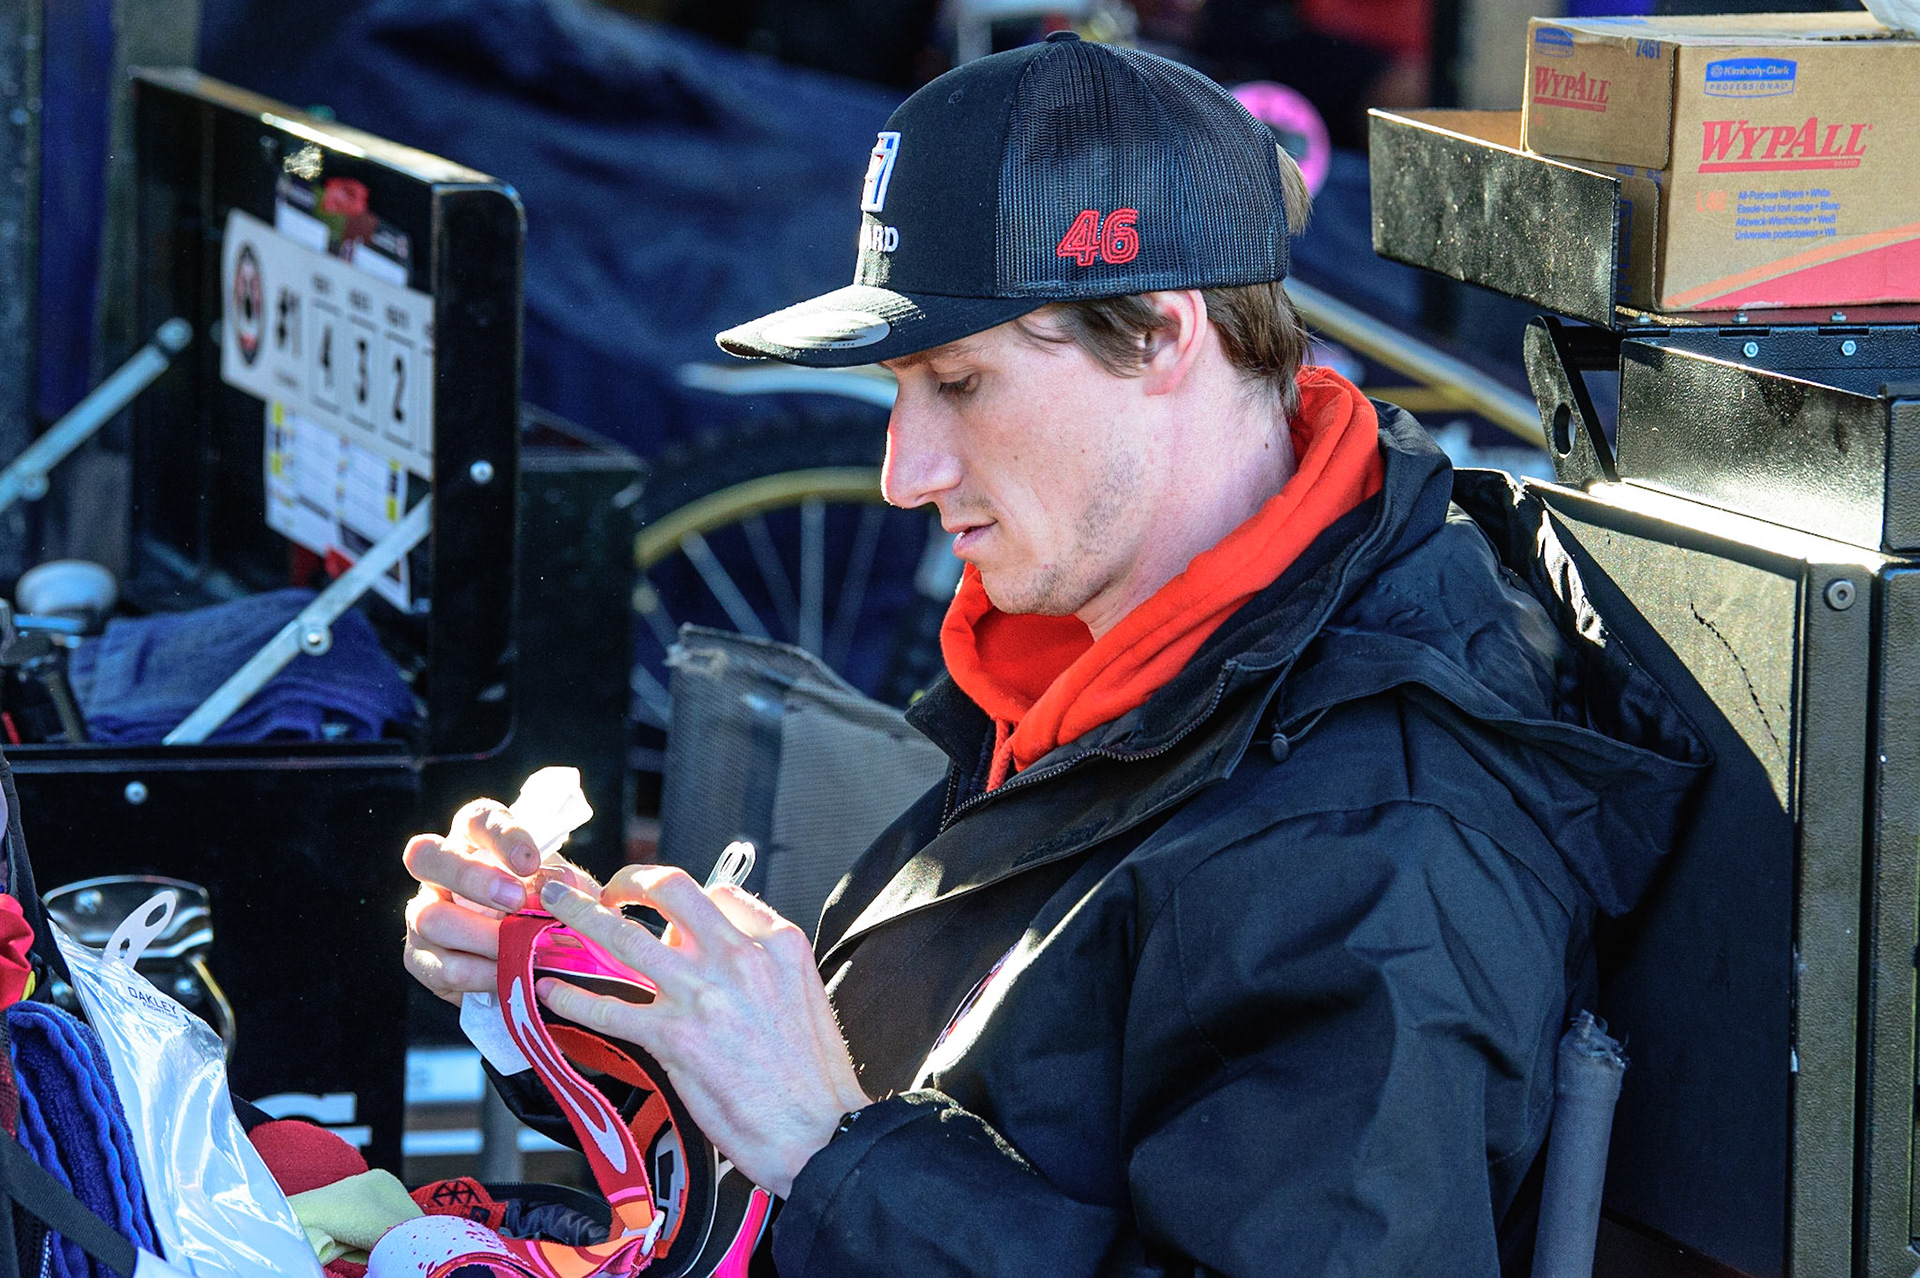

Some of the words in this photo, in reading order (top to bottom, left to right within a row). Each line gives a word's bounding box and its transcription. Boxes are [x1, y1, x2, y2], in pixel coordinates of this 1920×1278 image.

[1724, 65, 1789, 78] Kimberly-Clark
[1710, 82, 1787, 91] PROFESSIONAL
[1696, 190, 1727, 212] L40
[1738, 190, 1778, 201] All-Purpose
[1810, 188, 1831, 198] White
[1820, 201, 1840, 211] Blanc
[1057, 208, 1139, 266] 46
[355, 338, 369, 404] 3
[393, 356, 406, 423] 2
[128, 986, 177, 1015] OAKLEY
